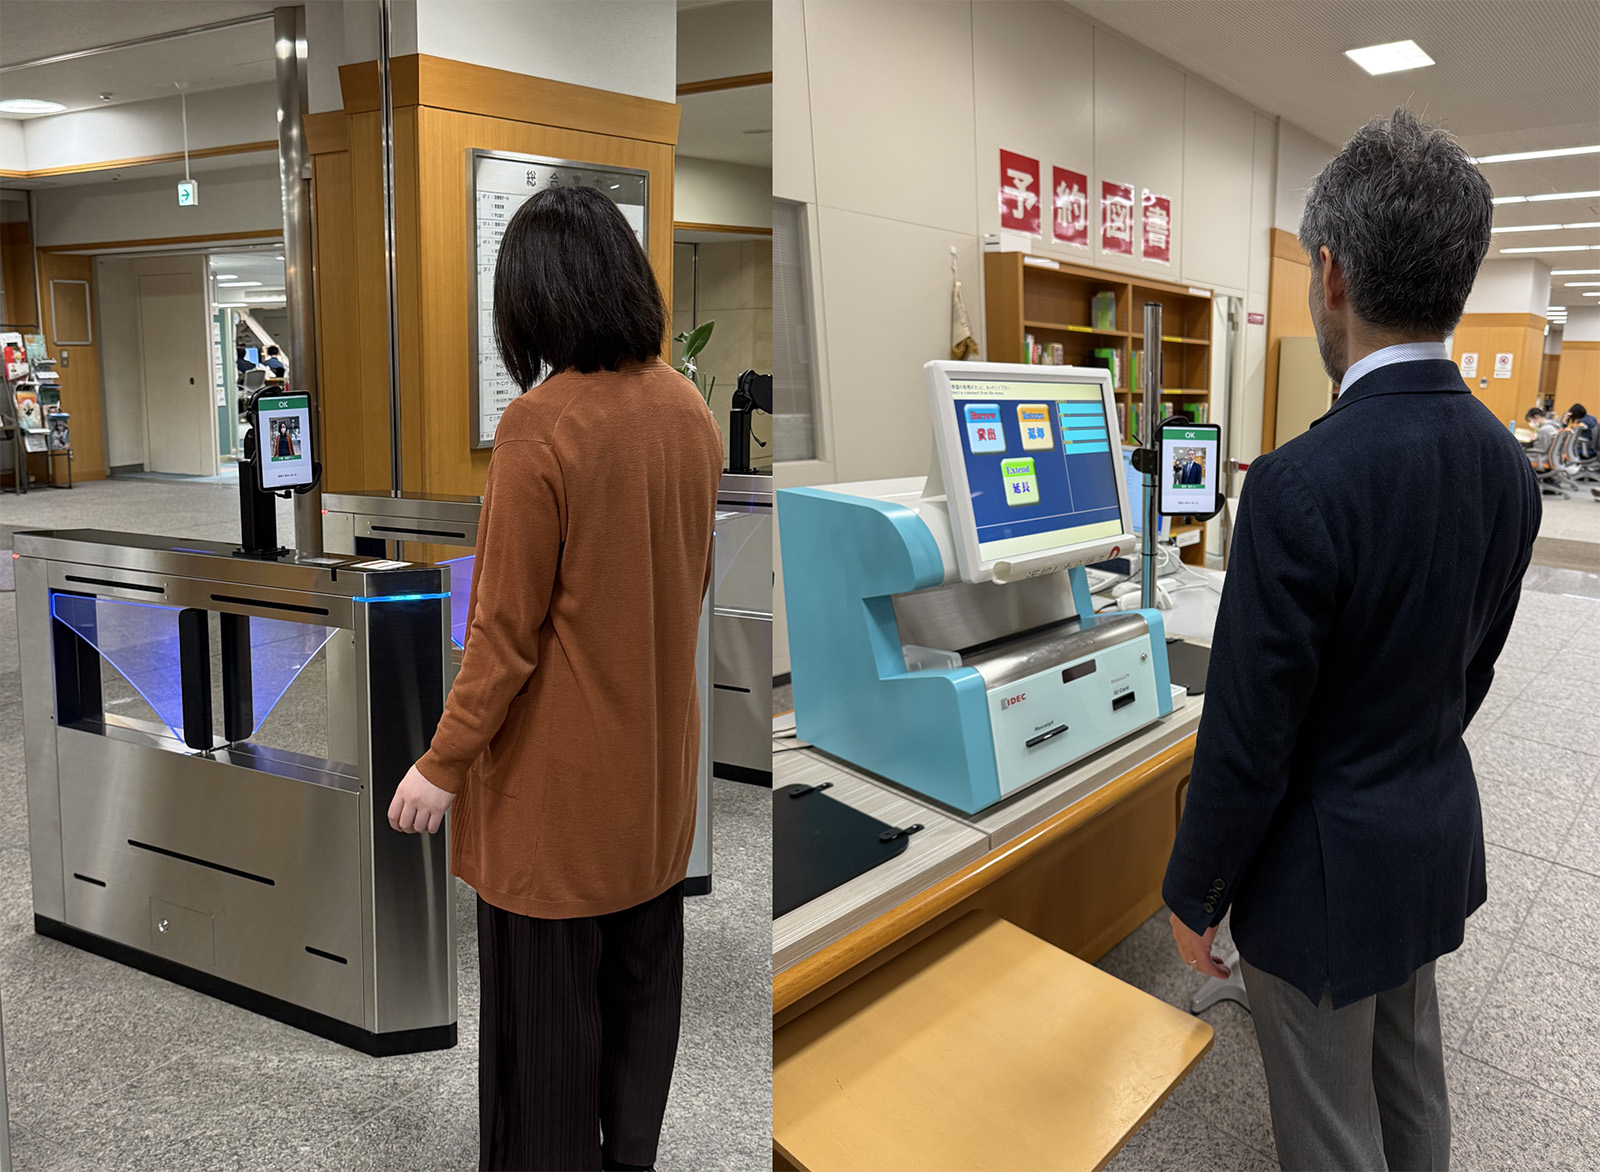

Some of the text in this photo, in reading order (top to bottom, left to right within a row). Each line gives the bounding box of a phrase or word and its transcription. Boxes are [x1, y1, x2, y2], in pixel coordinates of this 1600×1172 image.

[1003, 168, 1169, 250] 予約図書
[970, 411, 996, 420] Borrow
[1021, 411, 1045, 420] Return
[976, 428, 997, 442] 貸出
[1027, 427, 1045, 440] 返却
[1006, 465, 1030, 475] Extend
[1012, 481, 1031, 494] 延長
[1119, 685, 1130, 694] Card
[1006, 693, 1027, 707] IDEC
[1034, 720, 1054, 732] Receipt
